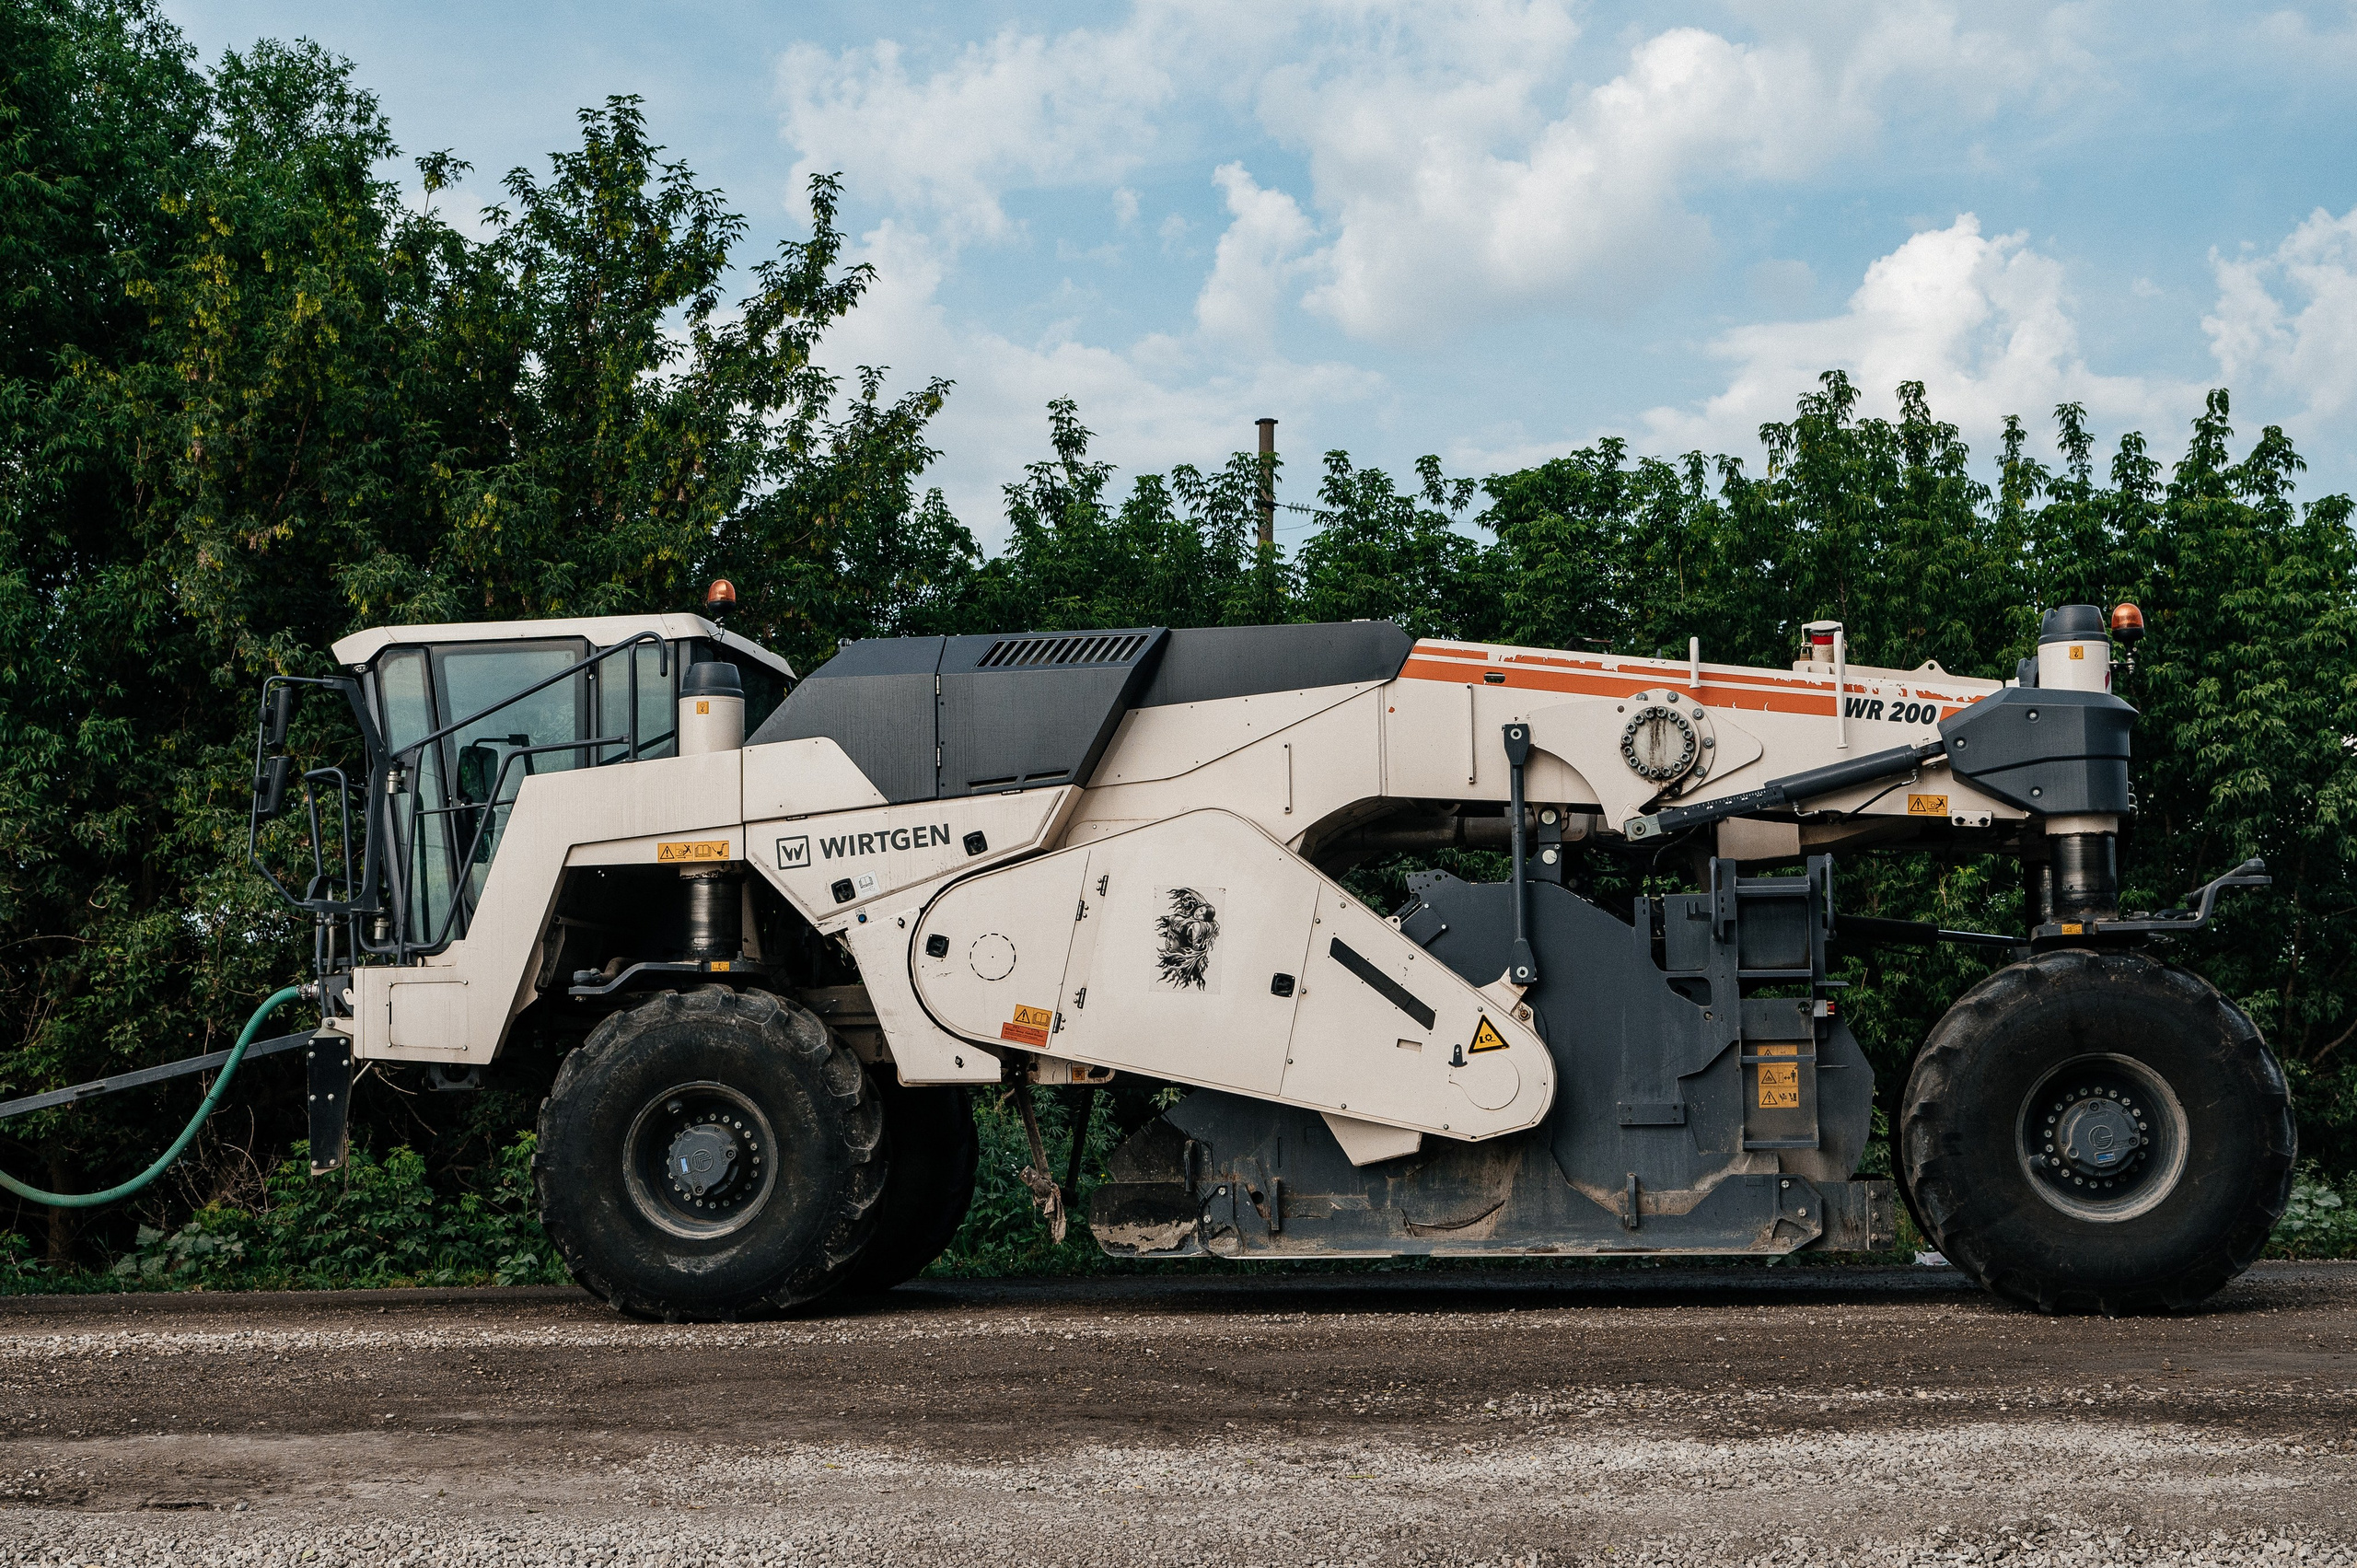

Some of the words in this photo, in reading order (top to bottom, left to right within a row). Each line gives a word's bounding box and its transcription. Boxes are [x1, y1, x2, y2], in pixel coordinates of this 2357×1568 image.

[1844, 697, 1885, 721] WR
[1887, 701, 1937, 726] 200
[819, 823, 951, 860] WIRTGEN
